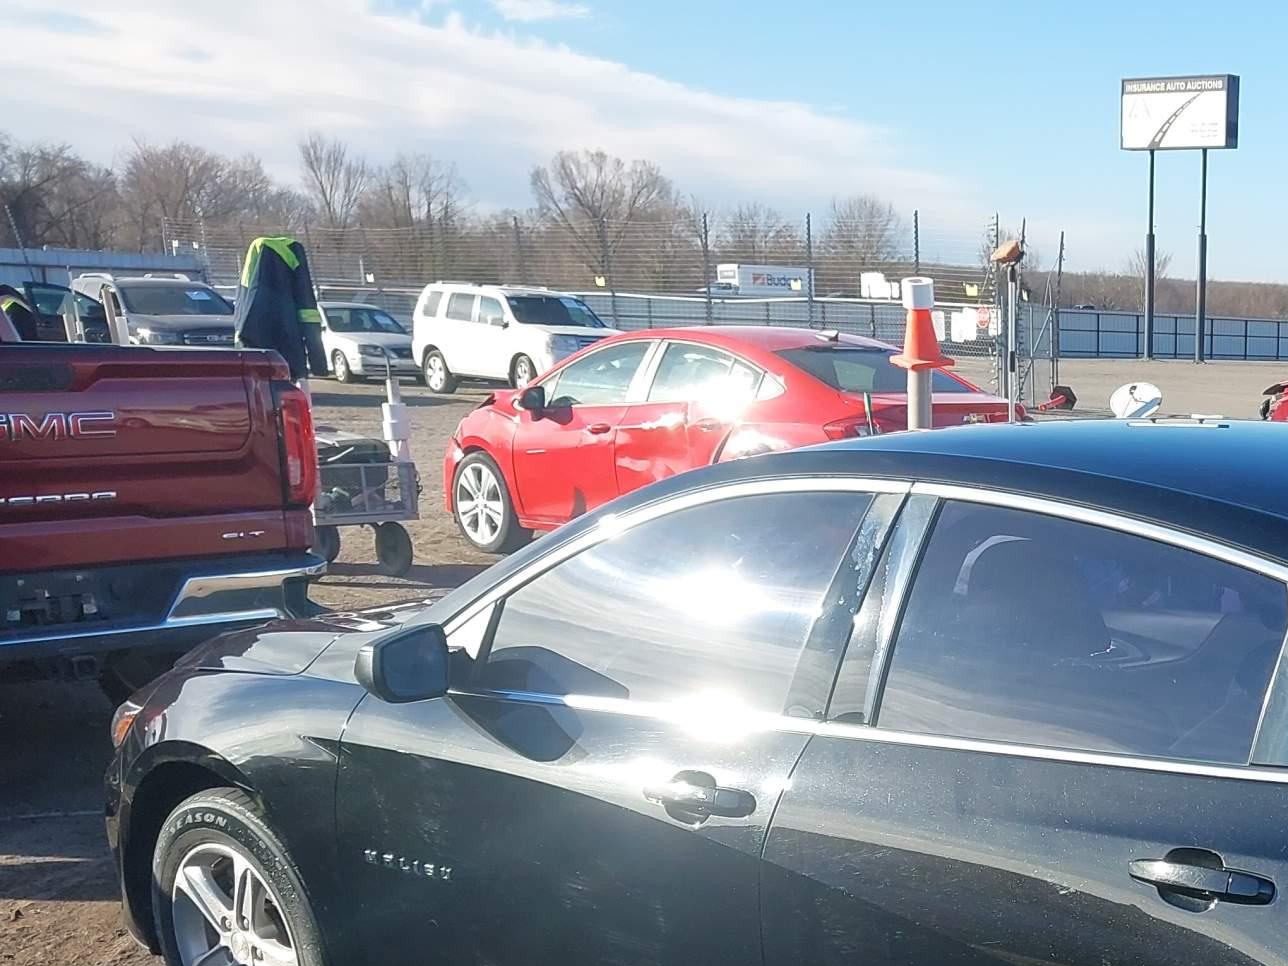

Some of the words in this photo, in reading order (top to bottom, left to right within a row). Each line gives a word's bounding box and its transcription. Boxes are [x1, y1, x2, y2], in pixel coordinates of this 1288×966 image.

[1125, 82, 1166, 93] INSURANCE
[1166, 80, 1185, 91] AUTO
[1186, 79, 1223, 90] AUCTIONS
[0, 411, 117, 441] MC
